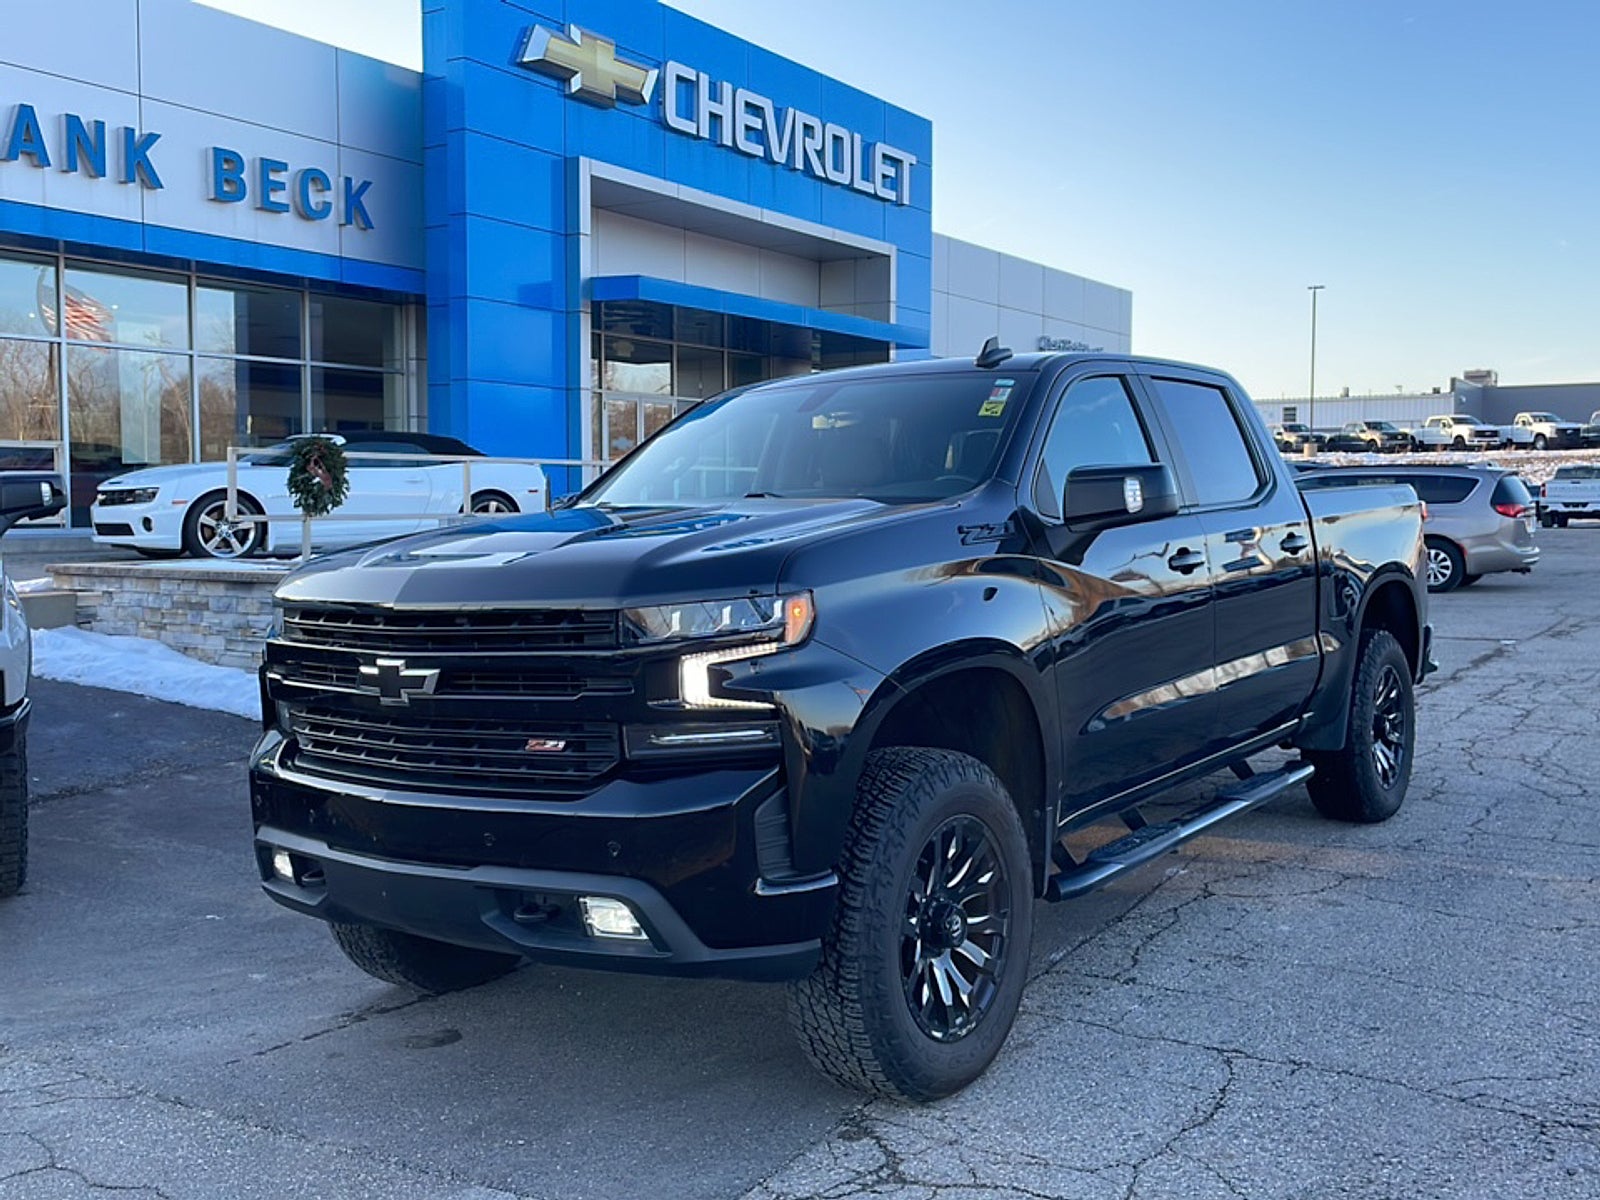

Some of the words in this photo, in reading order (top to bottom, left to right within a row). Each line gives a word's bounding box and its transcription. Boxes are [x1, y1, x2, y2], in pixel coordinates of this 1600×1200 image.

[1, 103, 164, 189] ANK
[207, 146, 374, 230] BECK
[663, 60, 917, 205] CHEVROLET
